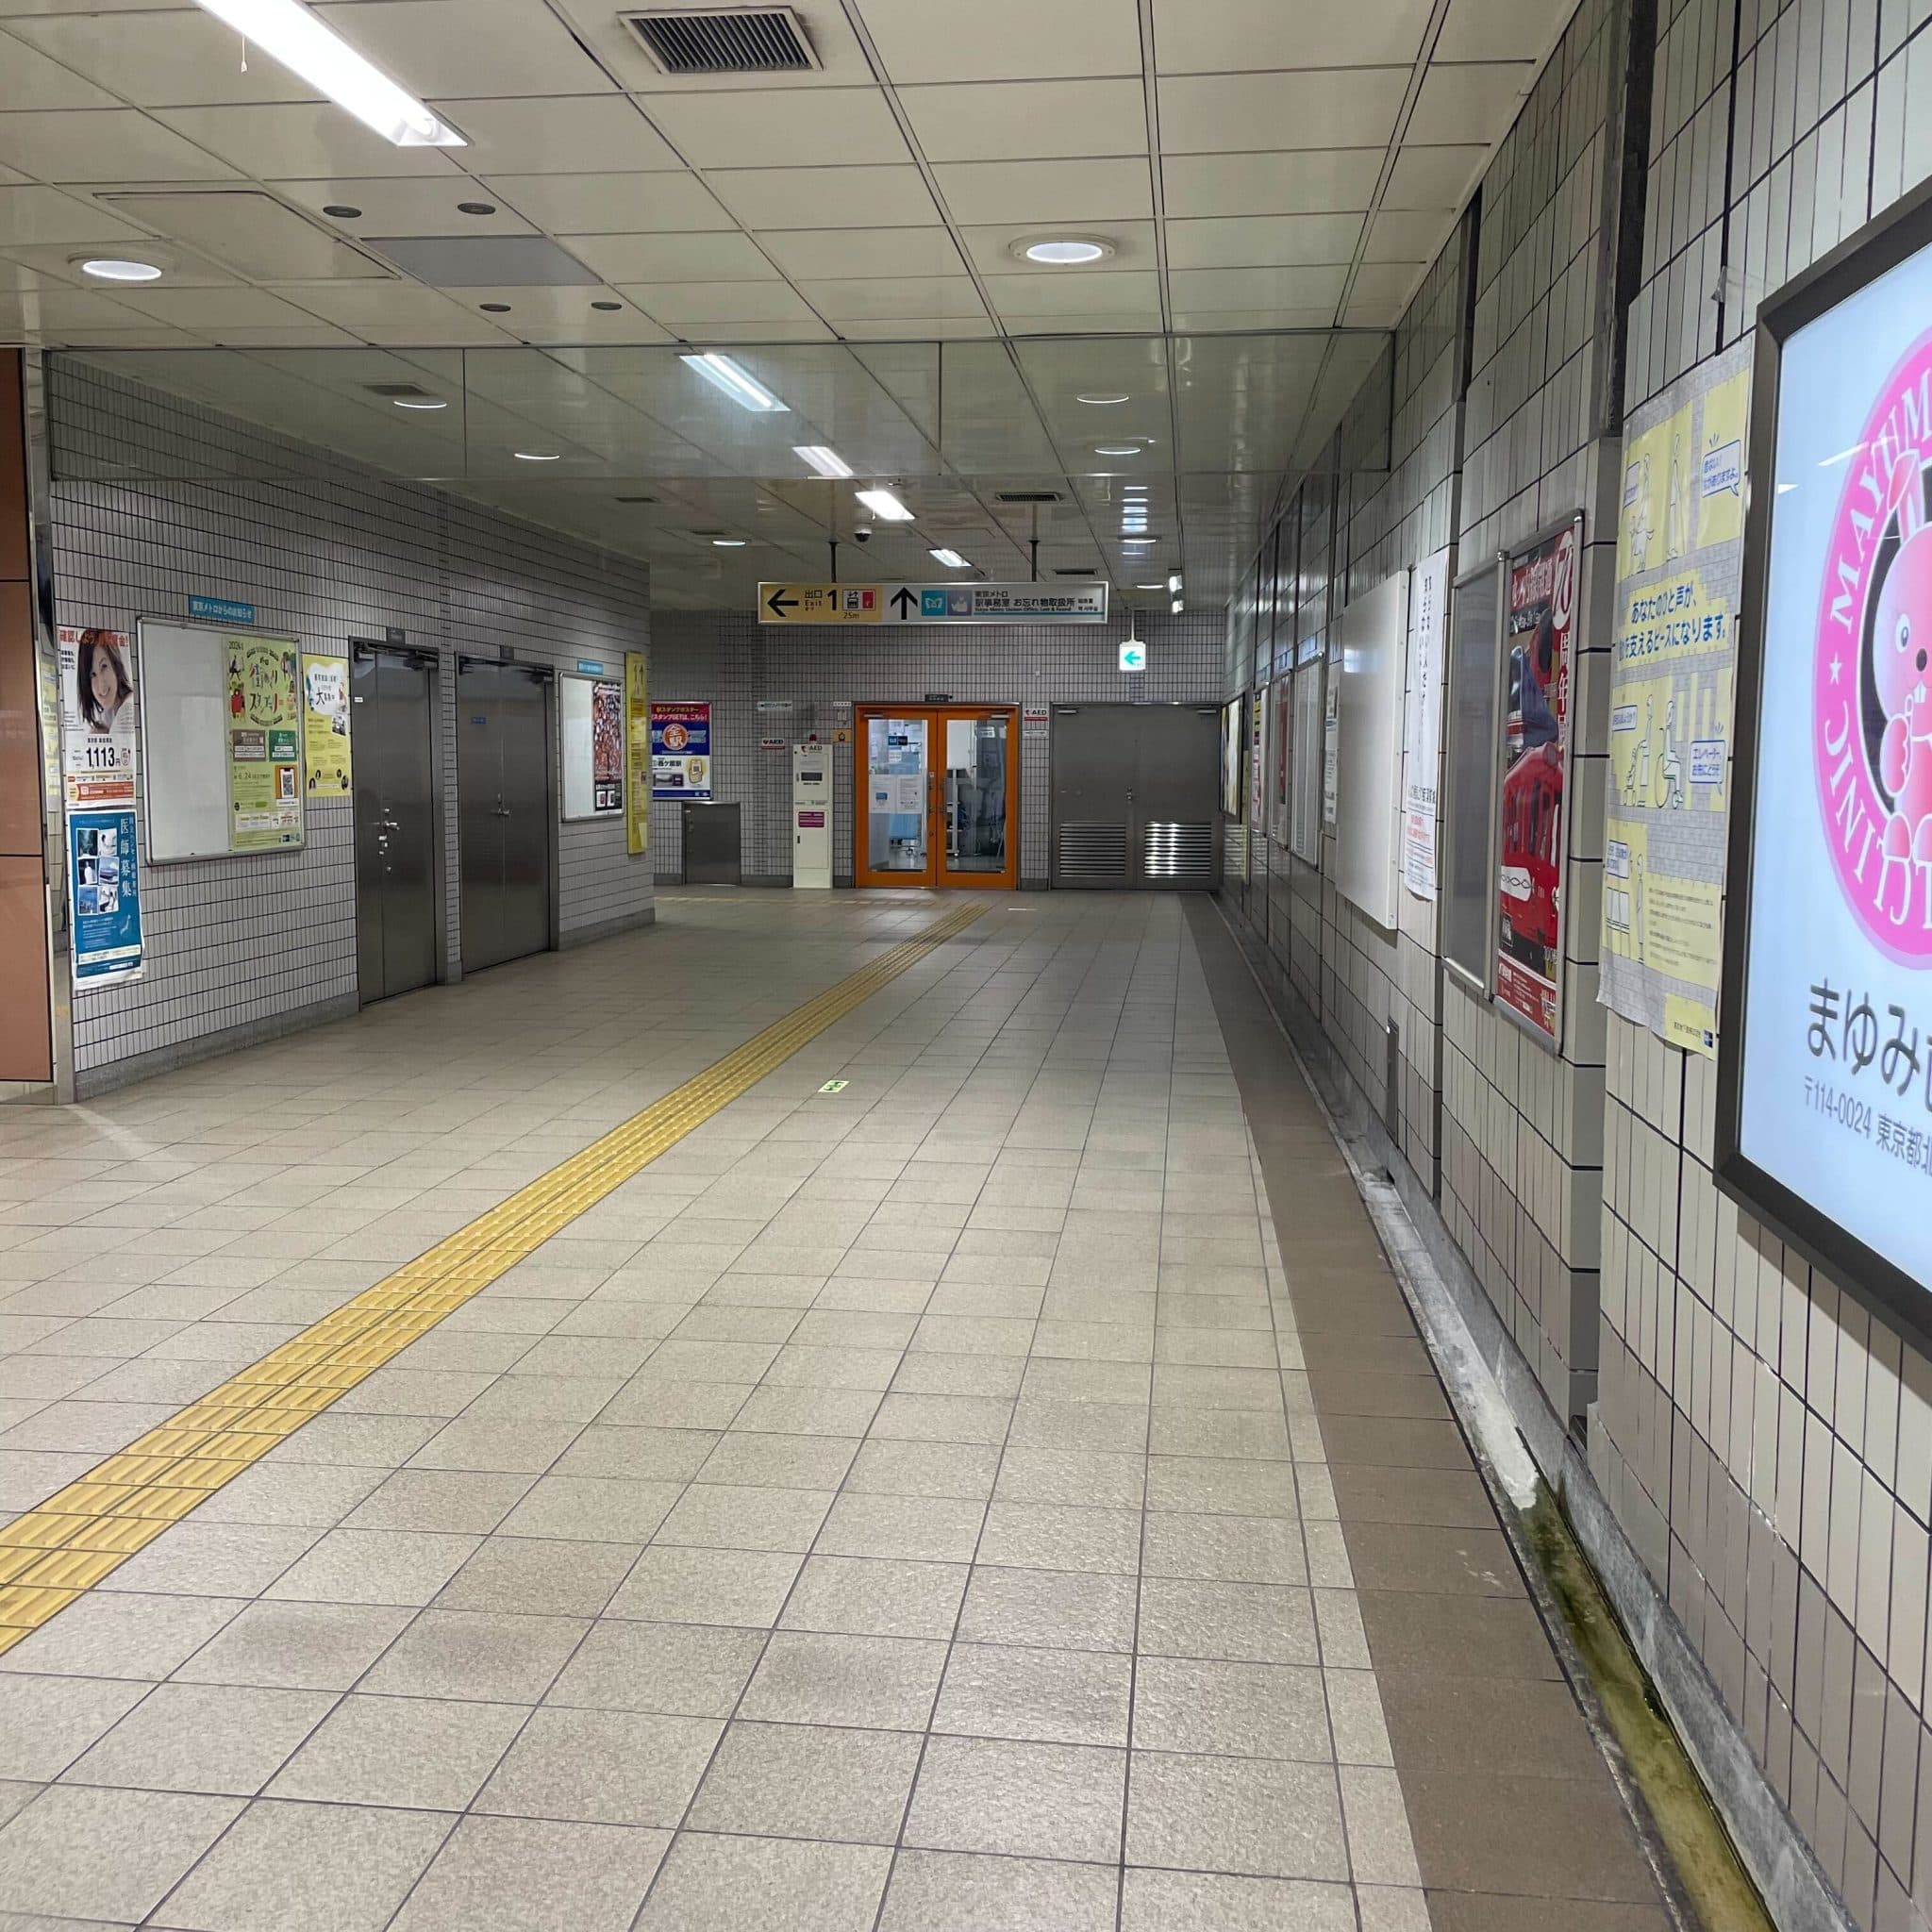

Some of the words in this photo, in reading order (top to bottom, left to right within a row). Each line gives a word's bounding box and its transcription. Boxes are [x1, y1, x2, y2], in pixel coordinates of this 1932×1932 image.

[805, 590, 823, 599] 出口
[827, 589, 837, 611] 1
[1805, 1075, 1873, 1140] 〒114-0024
